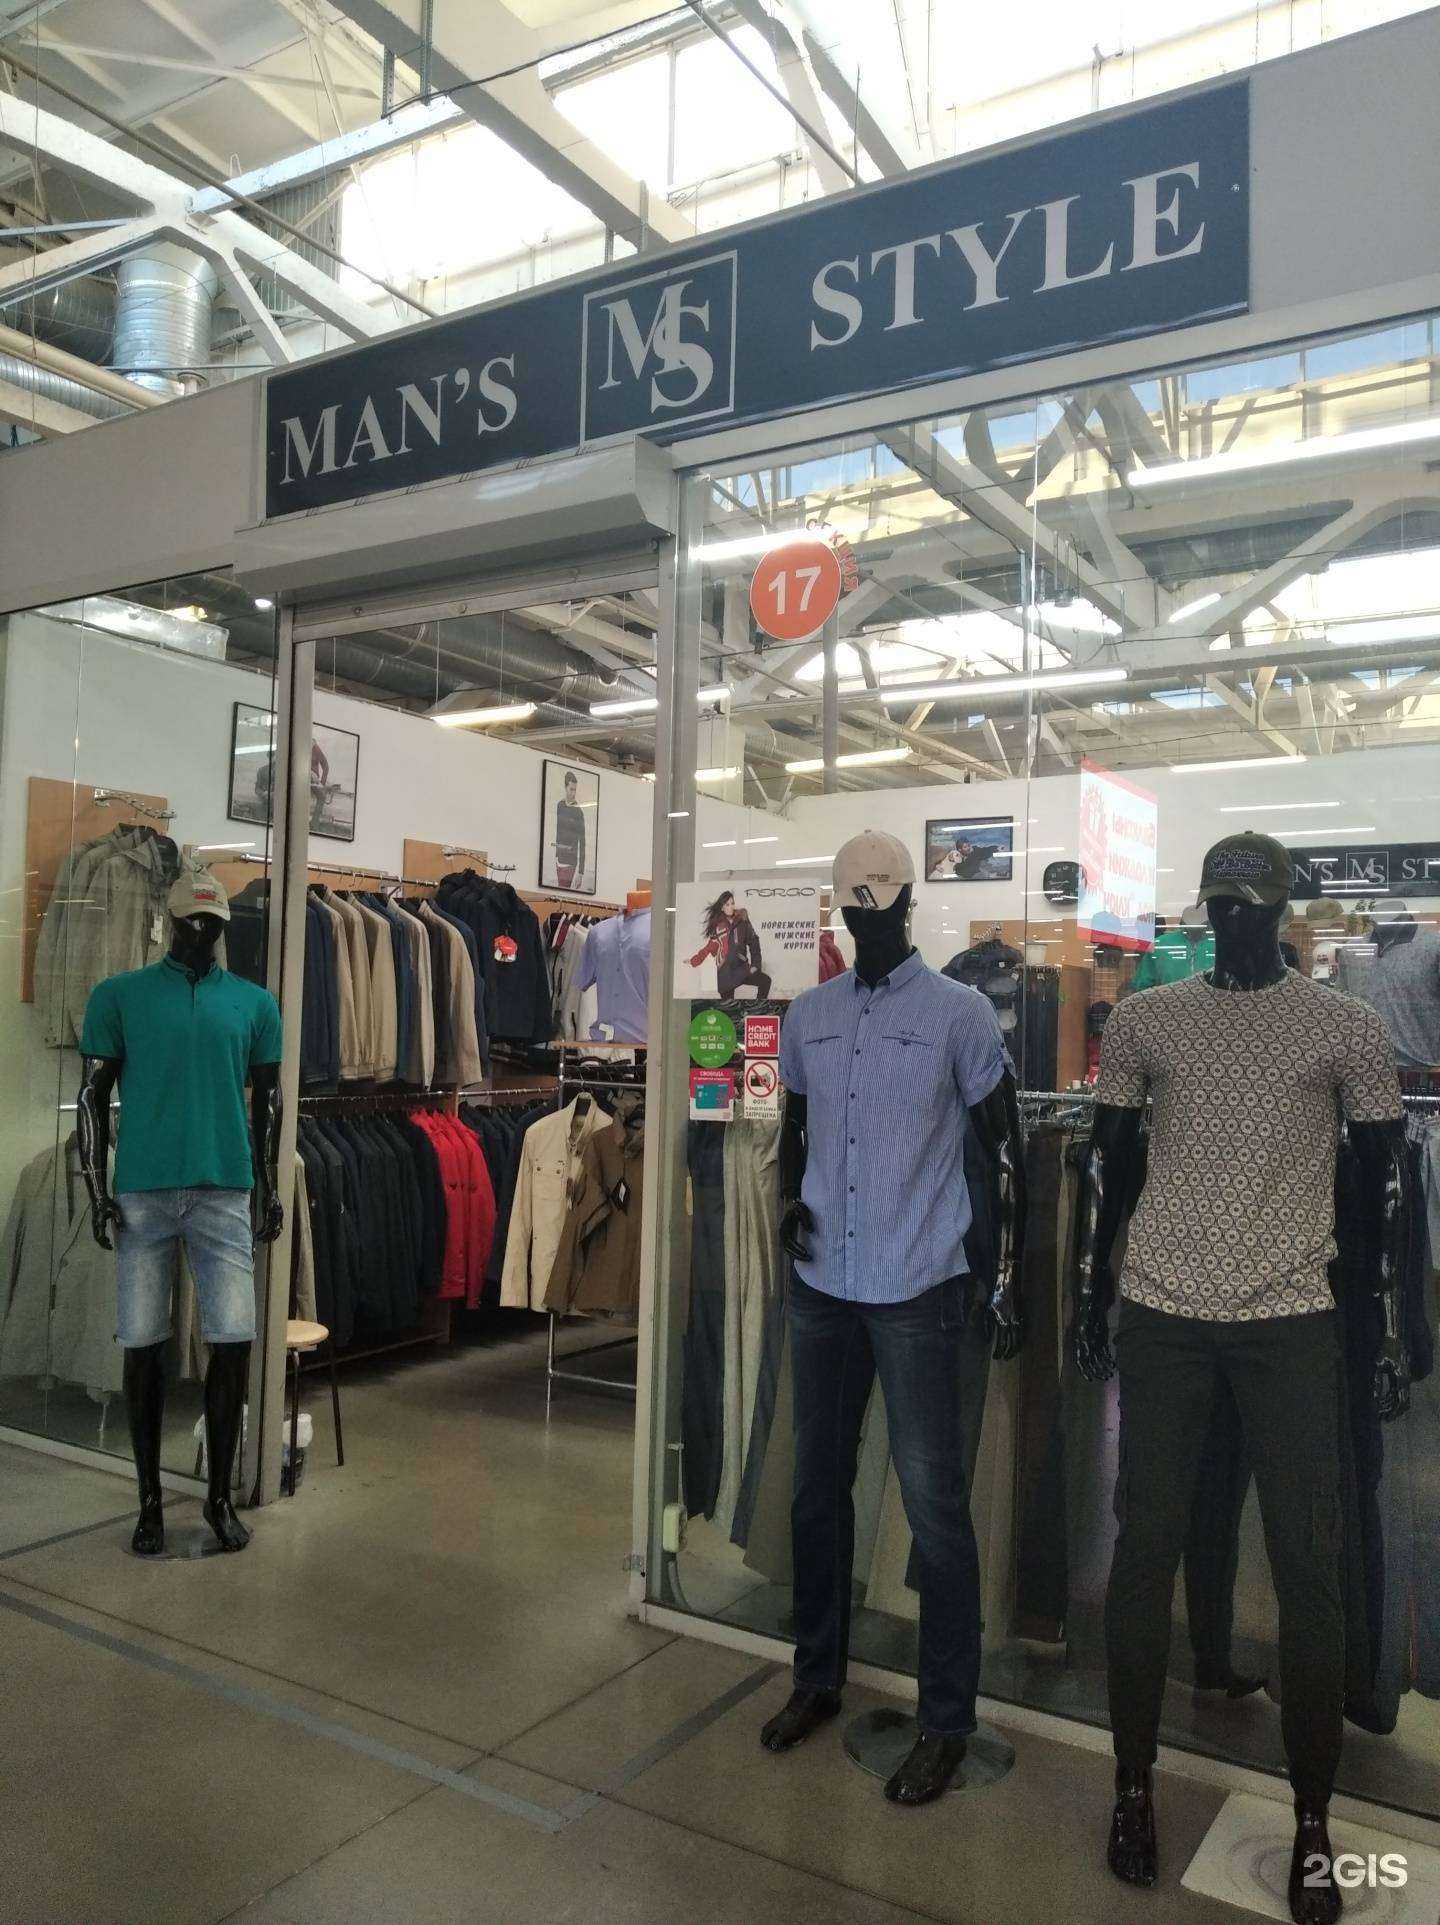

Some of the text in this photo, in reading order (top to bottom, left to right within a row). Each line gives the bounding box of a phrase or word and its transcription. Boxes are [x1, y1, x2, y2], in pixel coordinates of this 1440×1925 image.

[280, 161, 1205, 485] MAN'S MS STYLE
[768, 566, 822, 615] 17
[1293, 861, 1334, 882] N'S
[1401, 858, 1440, 880] ST
[761, 920, 815, 930] НОРВЕЖСКИЕ
[774, 931, 815, 940] МУЖСКИЕ
[783, 941, 815, 950] КУРТКИ
[747, 1025, 774, 1033] HOME
[747, 1032, 777, 1041] CREDIT
[747, 1040, 770, 1048] BANK
